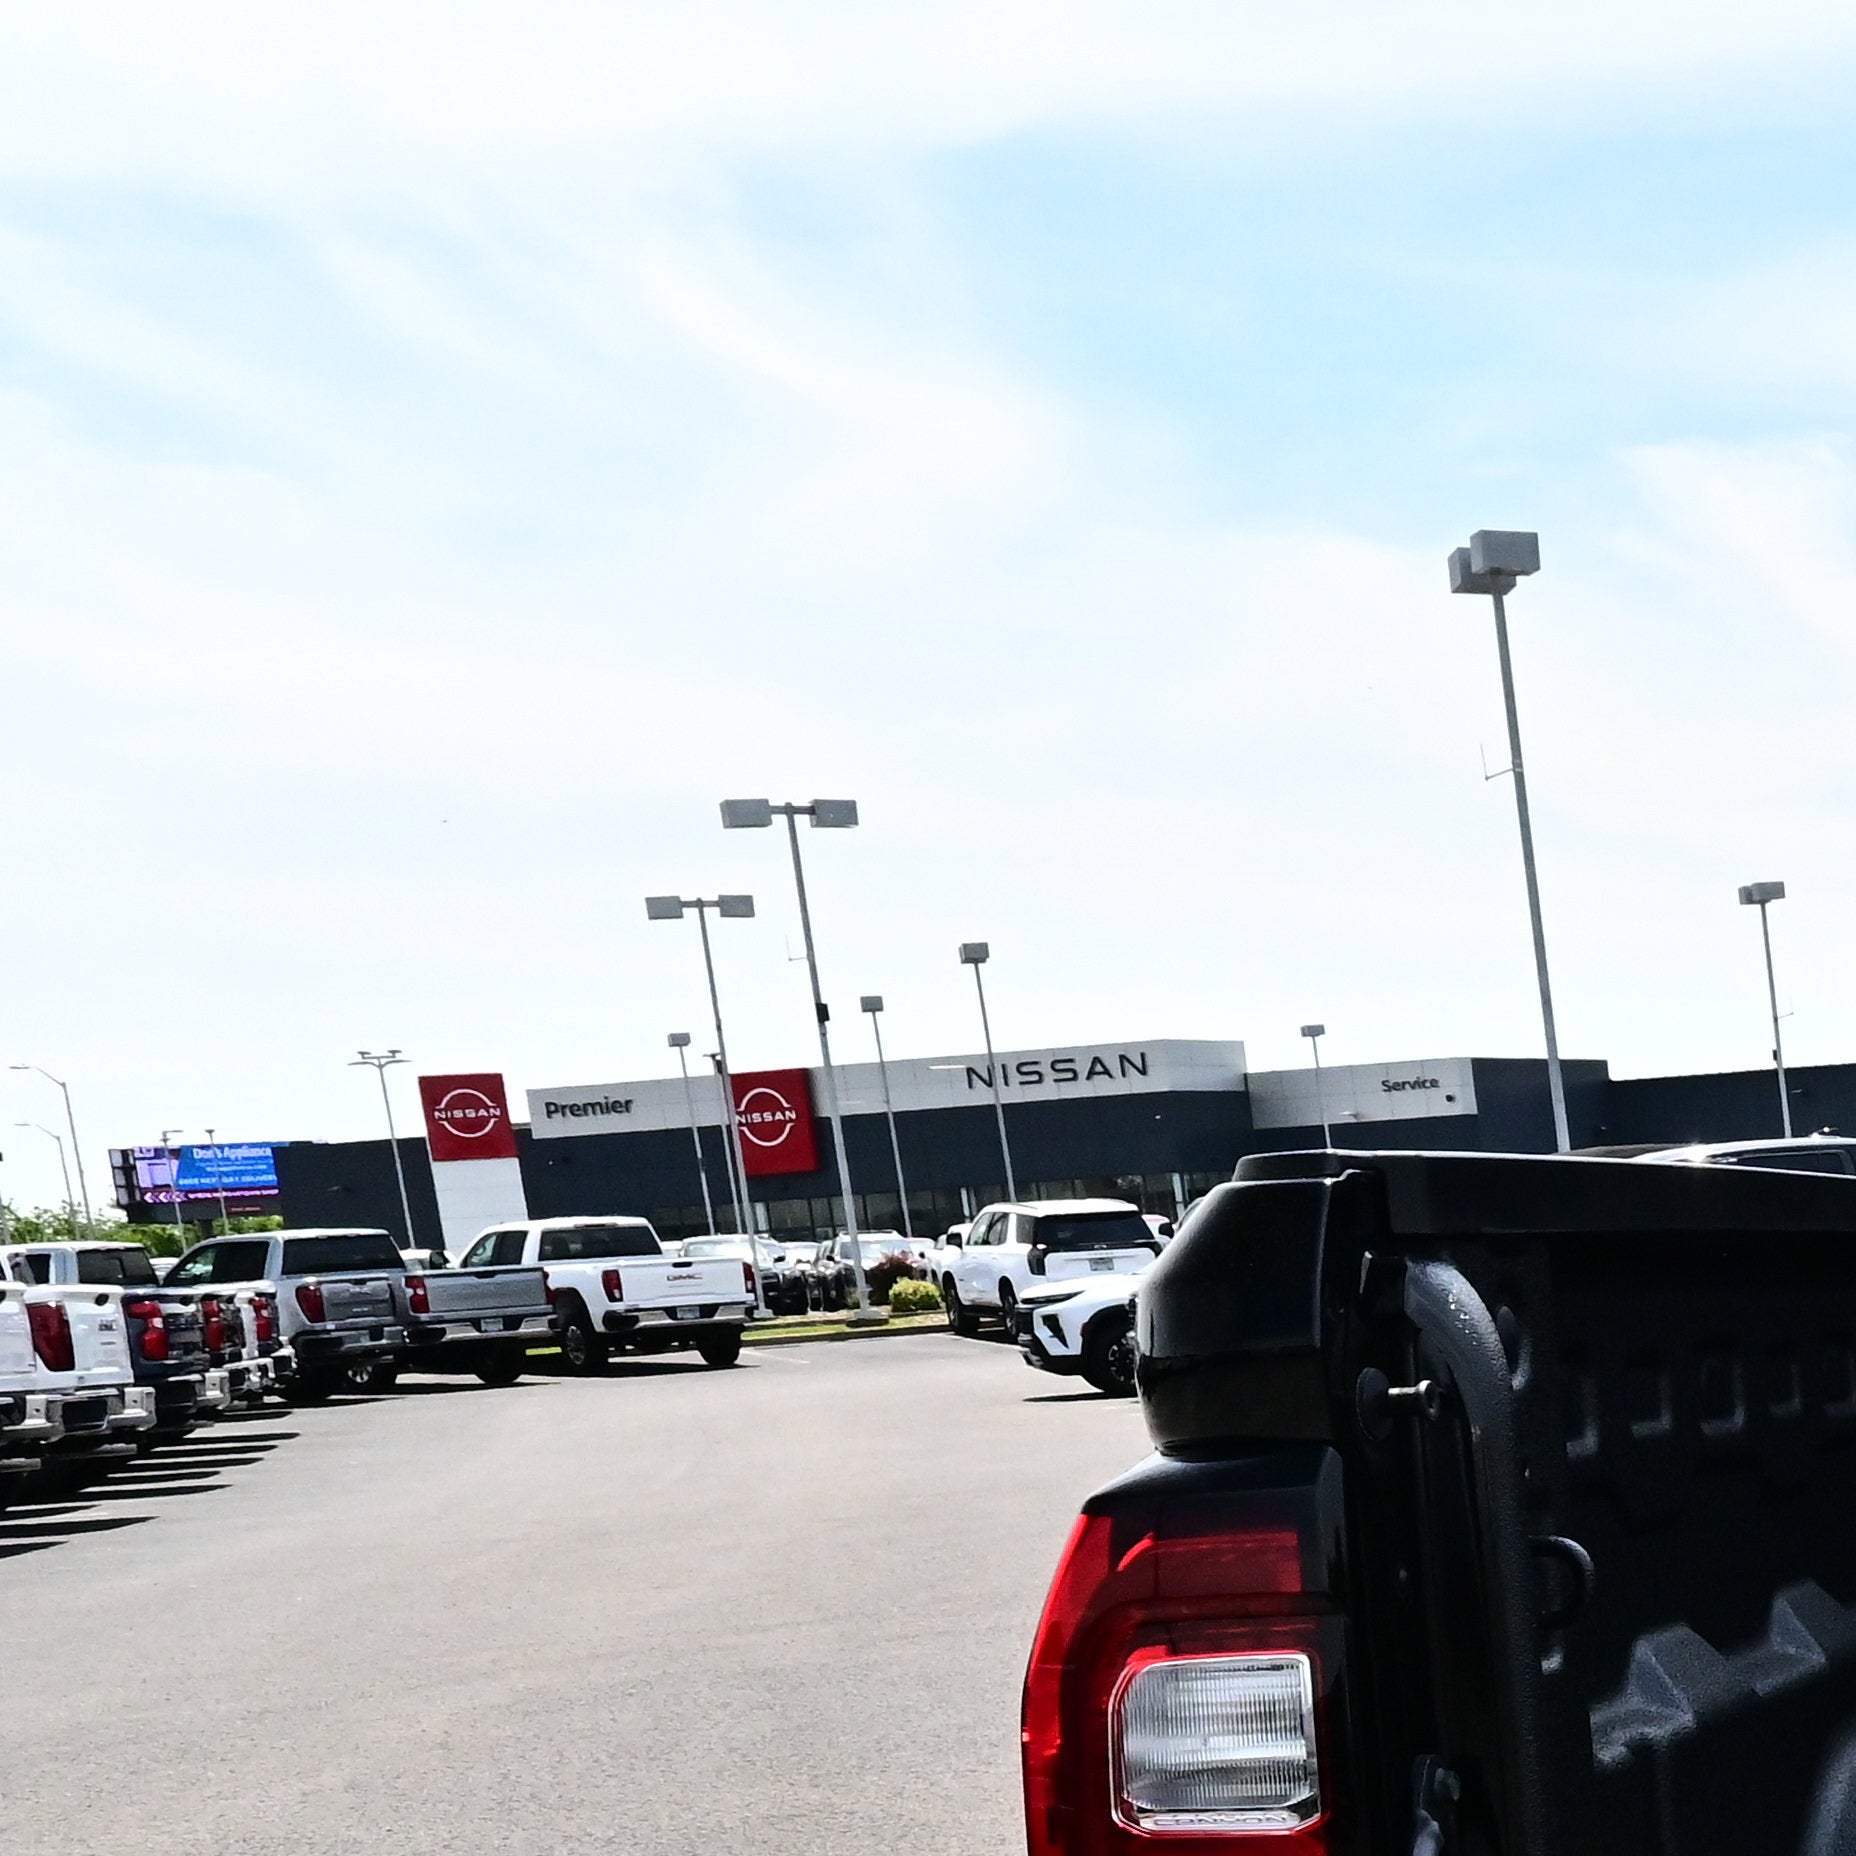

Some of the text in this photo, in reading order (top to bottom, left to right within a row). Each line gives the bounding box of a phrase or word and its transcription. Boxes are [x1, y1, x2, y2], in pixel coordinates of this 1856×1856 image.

[965, 1052, 1149, 1089] NISSAN
[1381, 1076, 1440, 1092] Service
[434, 1108, 501, 1119] NISSAN
[544, 1096, 634, 1119] Premier
[736, 1110, 796, 1124] NISSAN
